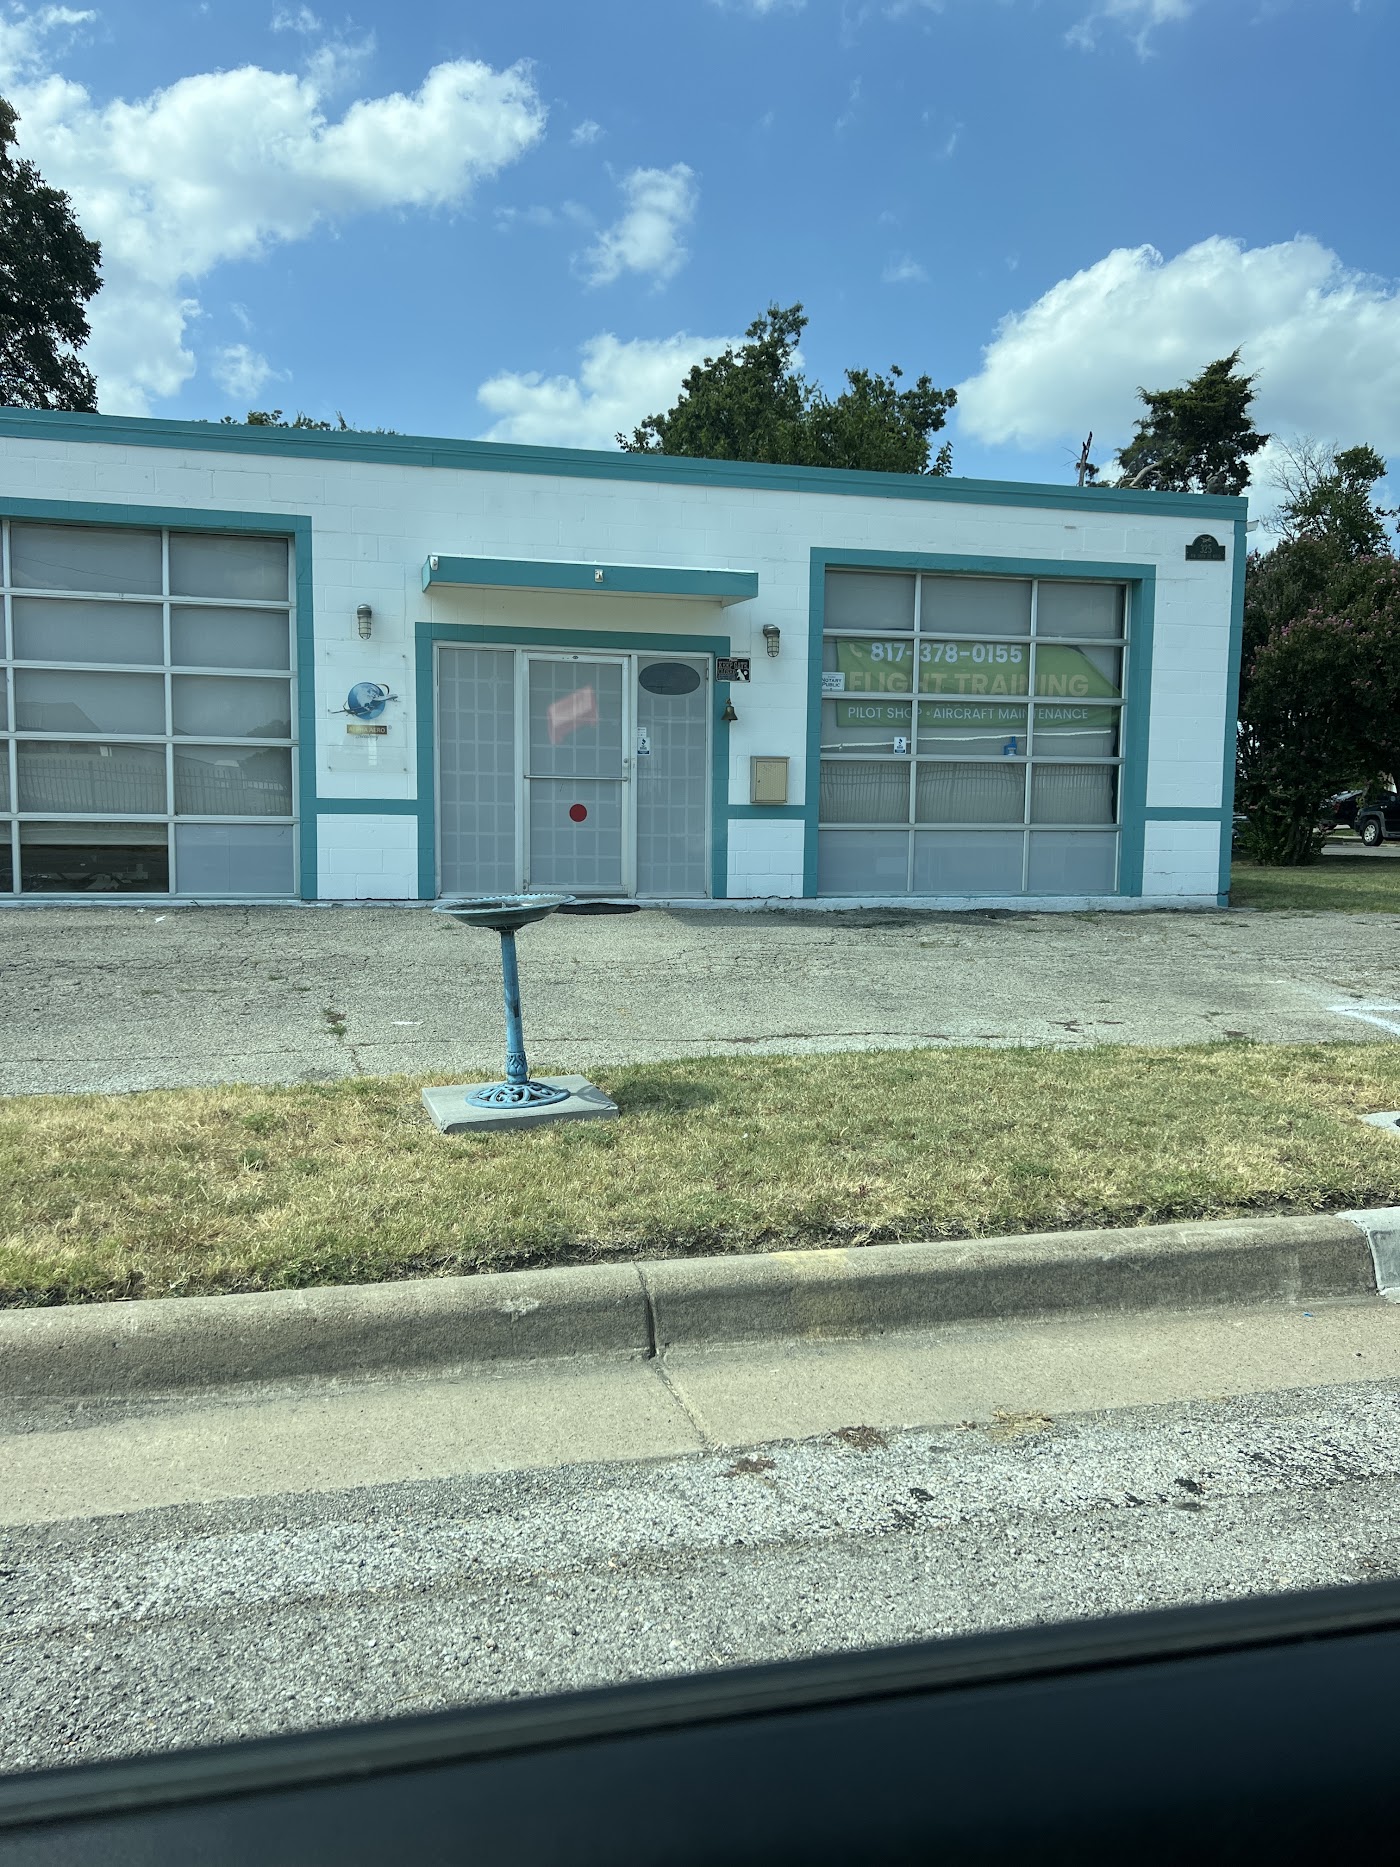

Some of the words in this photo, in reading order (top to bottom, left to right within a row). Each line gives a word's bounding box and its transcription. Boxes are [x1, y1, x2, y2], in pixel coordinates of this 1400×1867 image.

[871, 642, 1023, 663] 817-378-0155
[848, 707, 883, 718] PILOT
[933, 708, 994, 719] AIRCRAFT
